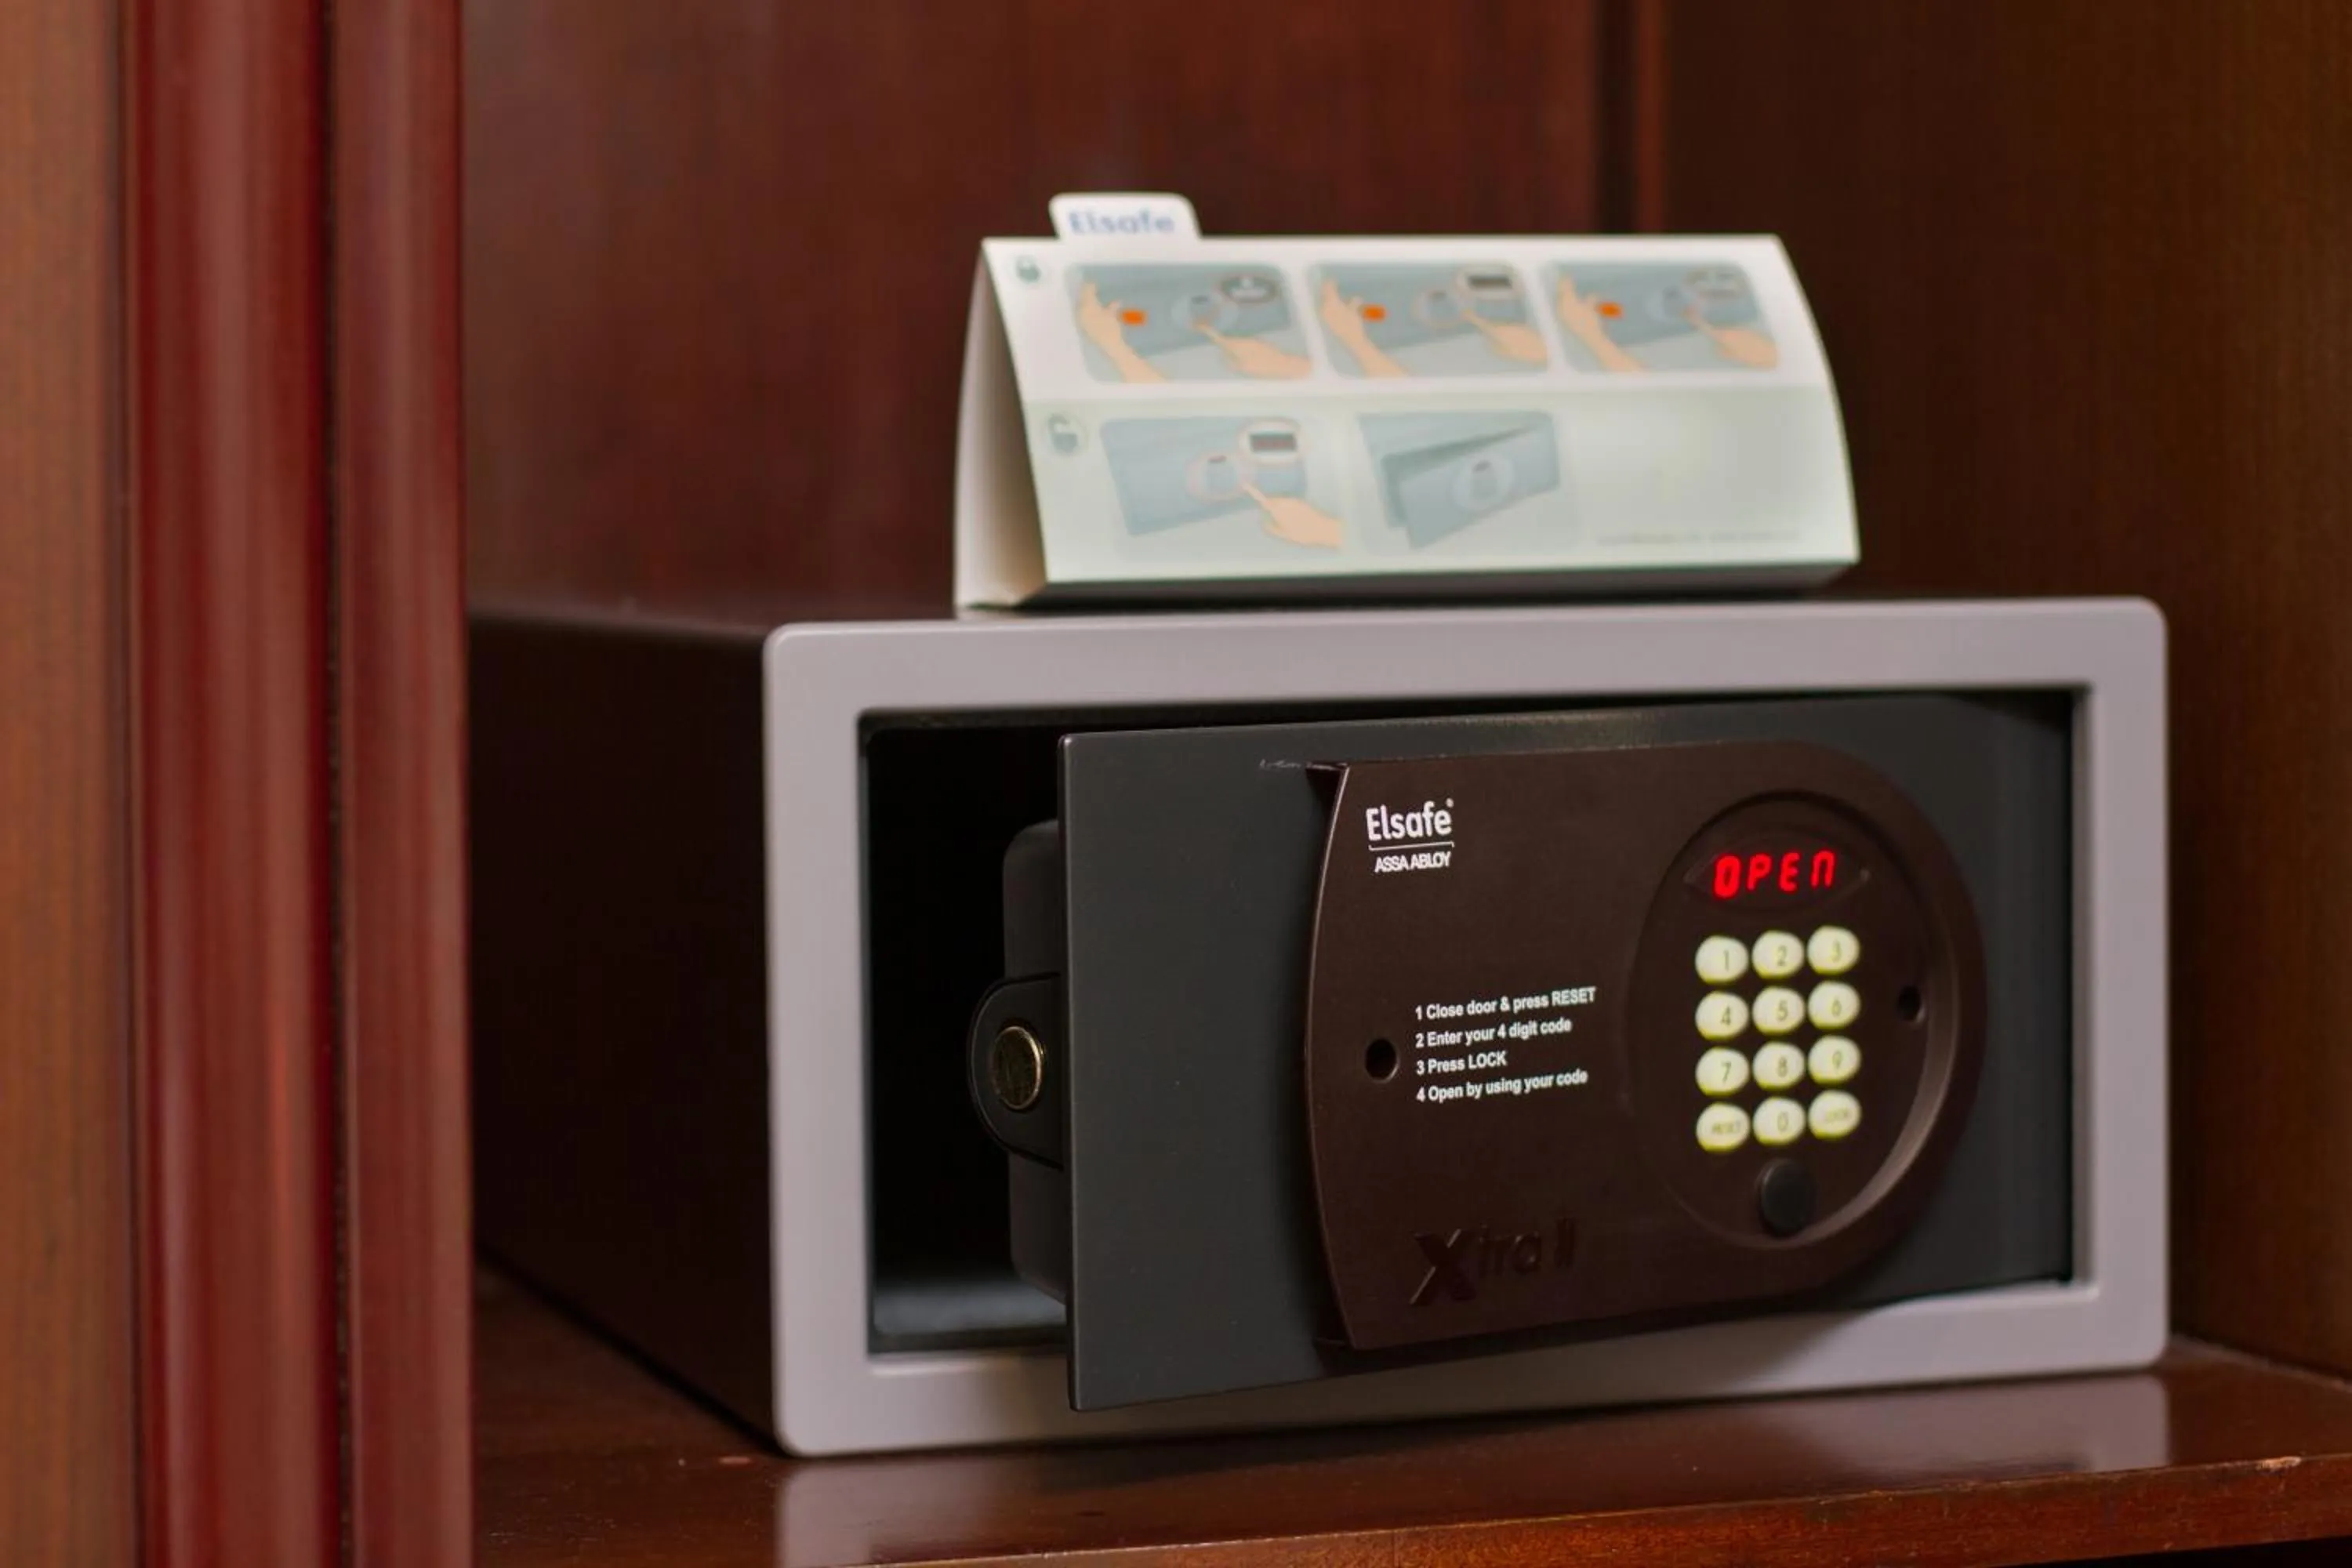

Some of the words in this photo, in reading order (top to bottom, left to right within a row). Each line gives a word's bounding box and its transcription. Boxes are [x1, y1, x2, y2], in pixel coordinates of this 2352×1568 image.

[1068, 208, 1176, 235] Elsafe
[1374, 854, 1409, 873] ASSA
[1410, 851, 1452, 869] ABLOY
[1713, 850, 1836, 898] OPEN
[1722, 949, 1730, 972] 1
[1777, 944, 1788, 967] 2
[1831, 938, 1842, 964] 3
[1415, 1005, 1423, 1021] 1
[1426, 1003, 1464, 1019] Close
[1467, 999, 1497, 1015] door
[1500, 996, 1511, 1012] &
[1513, 994, 1549, 1014] press
[1552, 985, 1596, 1006] RESET
[1777, 999, 1788, 1022] 5
[1831, 996, 1842, 1018] 6
[1720, 1005, 1731, 1028] 4
[1415, 1033, 1425, 1048] 2
[1427, 1031, 1463, 1047] Enter
[1465, 1027, 1495, 1047] your
[1497, 1023, 1506, 1039] 4
[1508, 1020, 1538, 1040] digit
[1540, 1017, 1573, 1035] code
[1416, 1060, 1425, 1076] 3
[1428, 1058, 1465, 1074] Press
[1468, 1050, 1508, 1069] LOCK
[1721, 1060, 1732, 1084] 7
[1777, 1054, 1788, 1078] 8
[1832, 1050, 1843, 1072] 9
[1416, 1087, 1425, 1102] 4
[1428, 1084, 1464, 1104] Open
[1466, 1081, 1483, 1099] by
[1485, 1077, 1522, 1095] using
[1523, 1073, 1554, 1091] your
[1556, 1068, 1588, 1086] code
